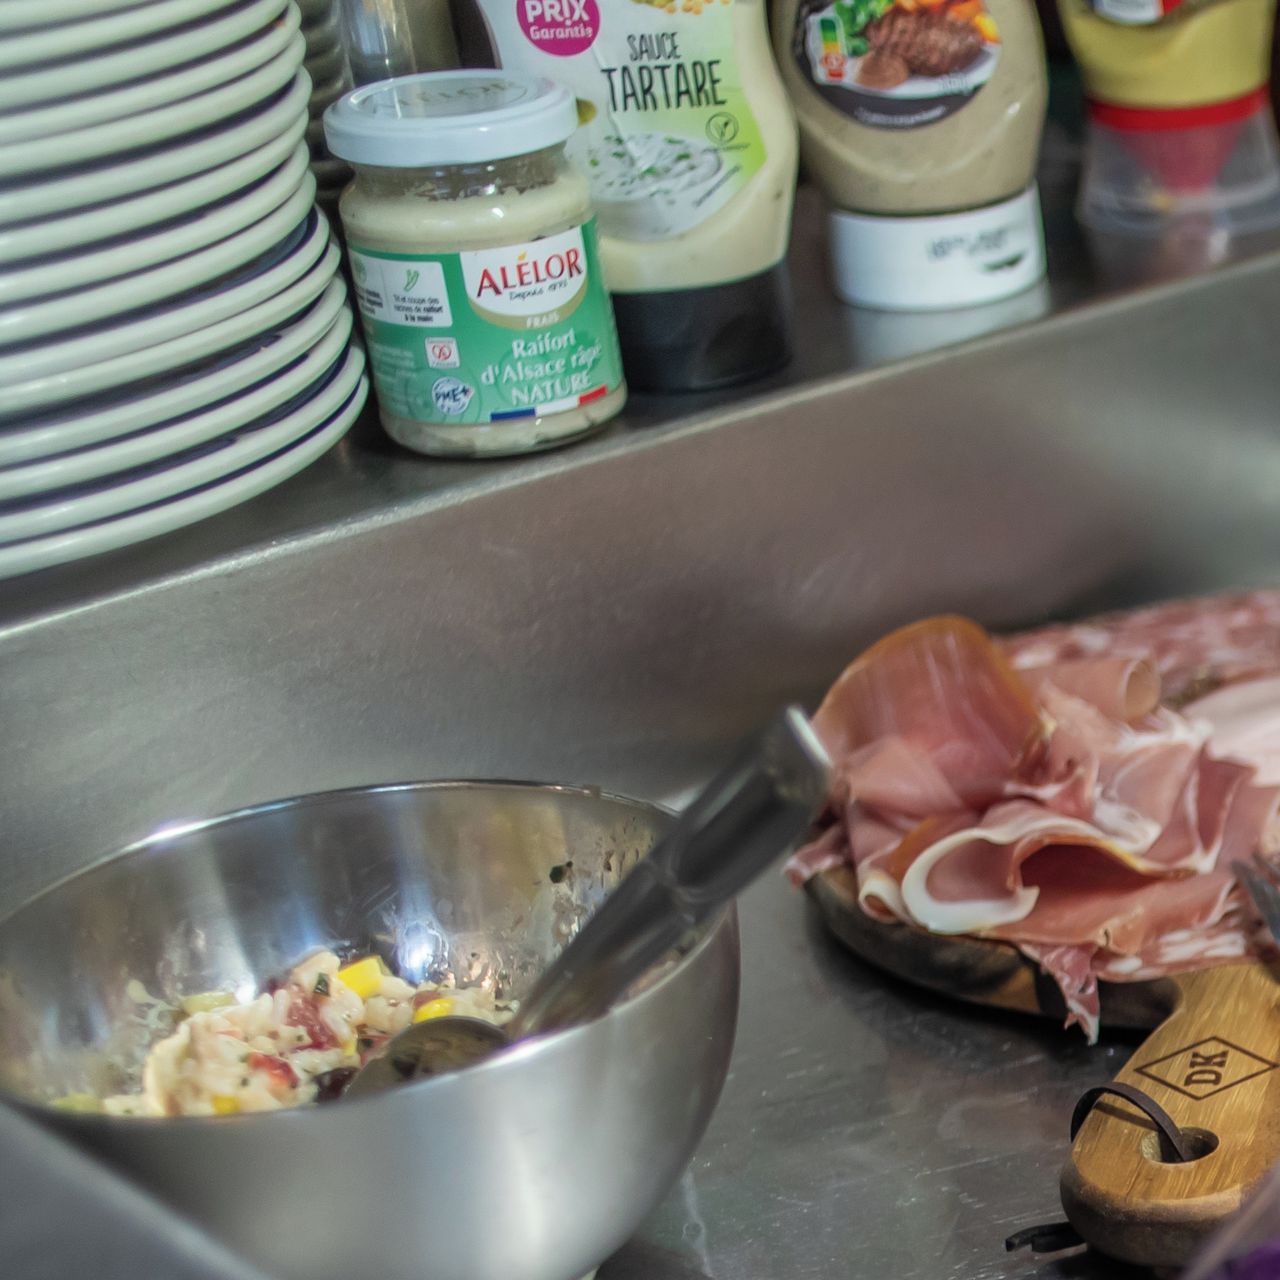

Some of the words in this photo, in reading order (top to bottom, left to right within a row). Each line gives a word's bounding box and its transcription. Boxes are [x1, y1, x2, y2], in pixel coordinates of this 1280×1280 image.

[529, 26, 593, 41] Garantie
[626, 32, 682, 61] SAUCE
[600, 59, 728, 113] TARTARE
[476, 248, 583, 298] ALÉLOR
[526, 311, 560, 329] FRAIS
[511, 328, 576, 359] Raifort
[481, 357, 566, 385] d'Alsace
[511, 370, 593, 406] NATURE
[1184, 1050, 1229, 1087] DK
